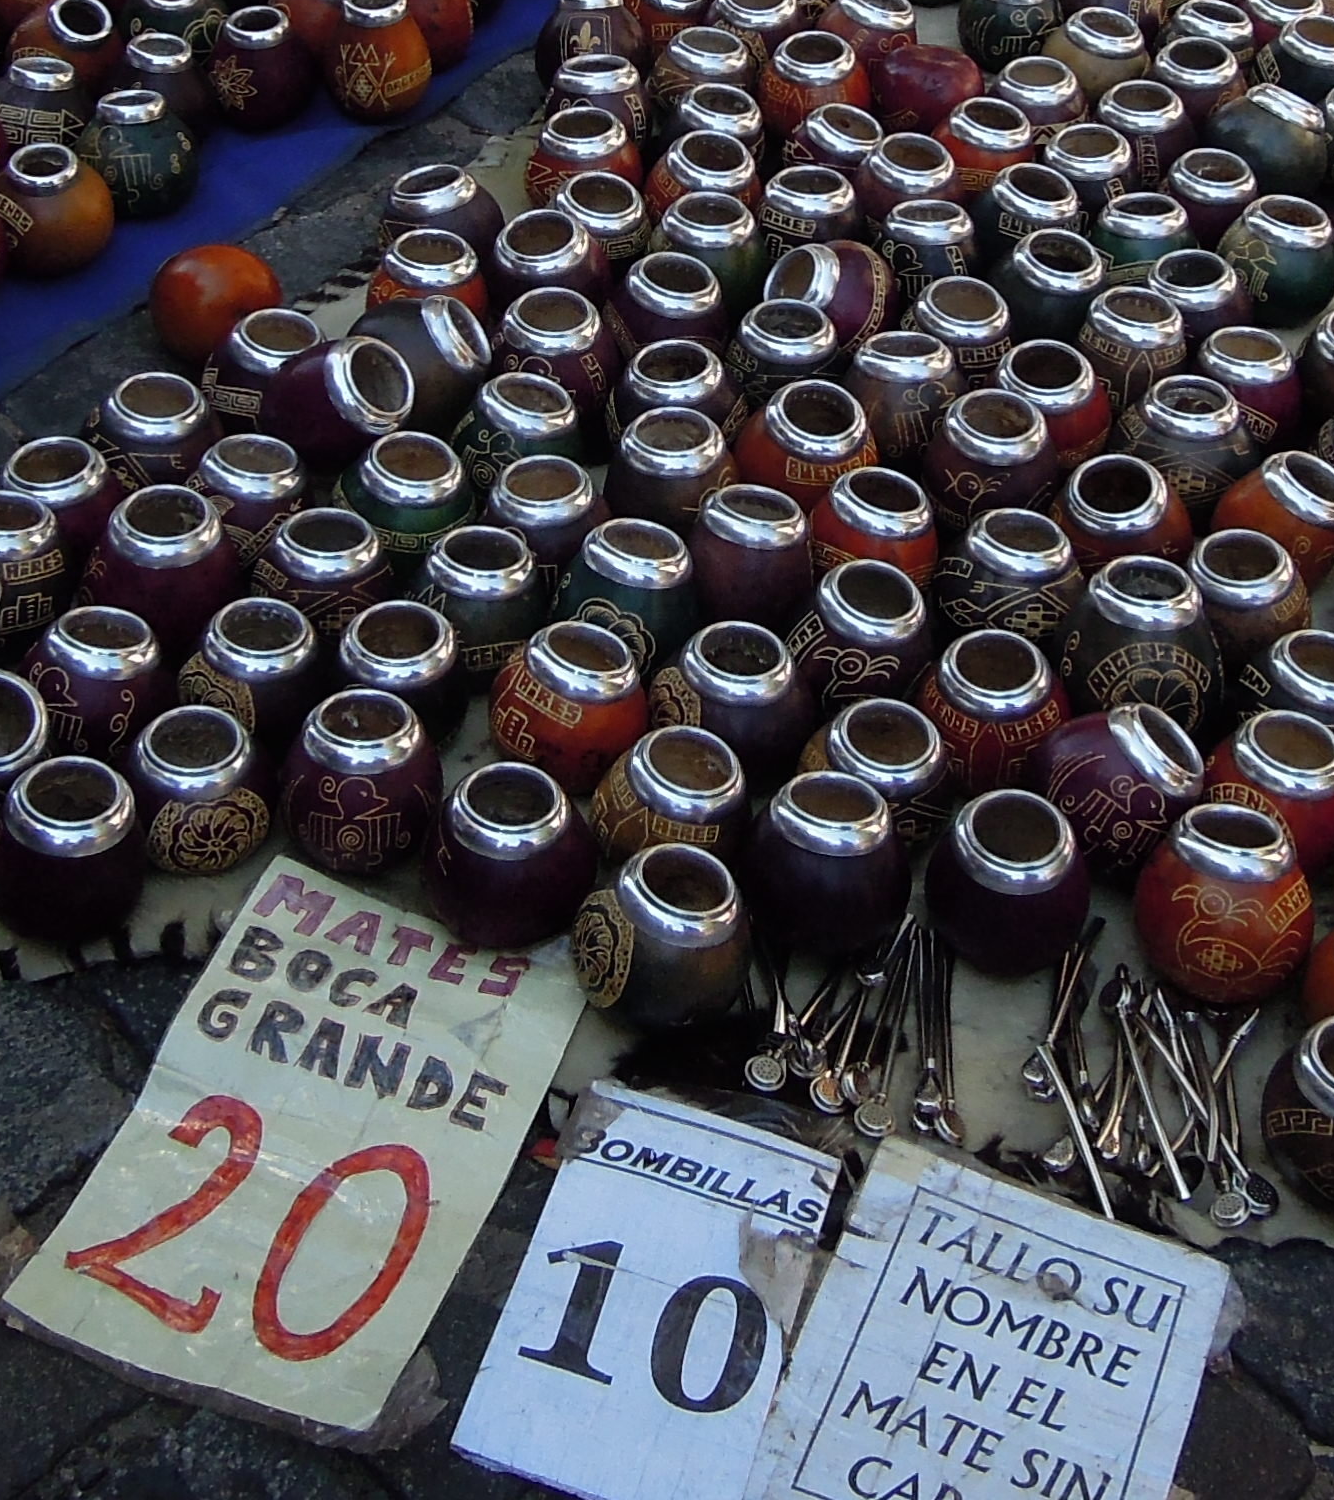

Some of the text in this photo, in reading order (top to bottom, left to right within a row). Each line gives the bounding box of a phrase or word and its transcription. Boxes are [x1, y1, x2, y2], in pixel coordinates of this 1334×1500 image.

[226, 925, 419, 1028] BOCA
[252, 874, 531, 997] MATES
[196, 988, 509, 1132] GRANDE
[64, 1094, 433, 1362] 20
[917, 1206, 1172, 1333] TALLO SU
[518, 1240, 768, 1413] 10
[899, 1266, 1141, 1388] NOMBRE
[918, 1341, 1067, 1431] EN EL
[841, 1380, 1113, 1500] MATE SIN
